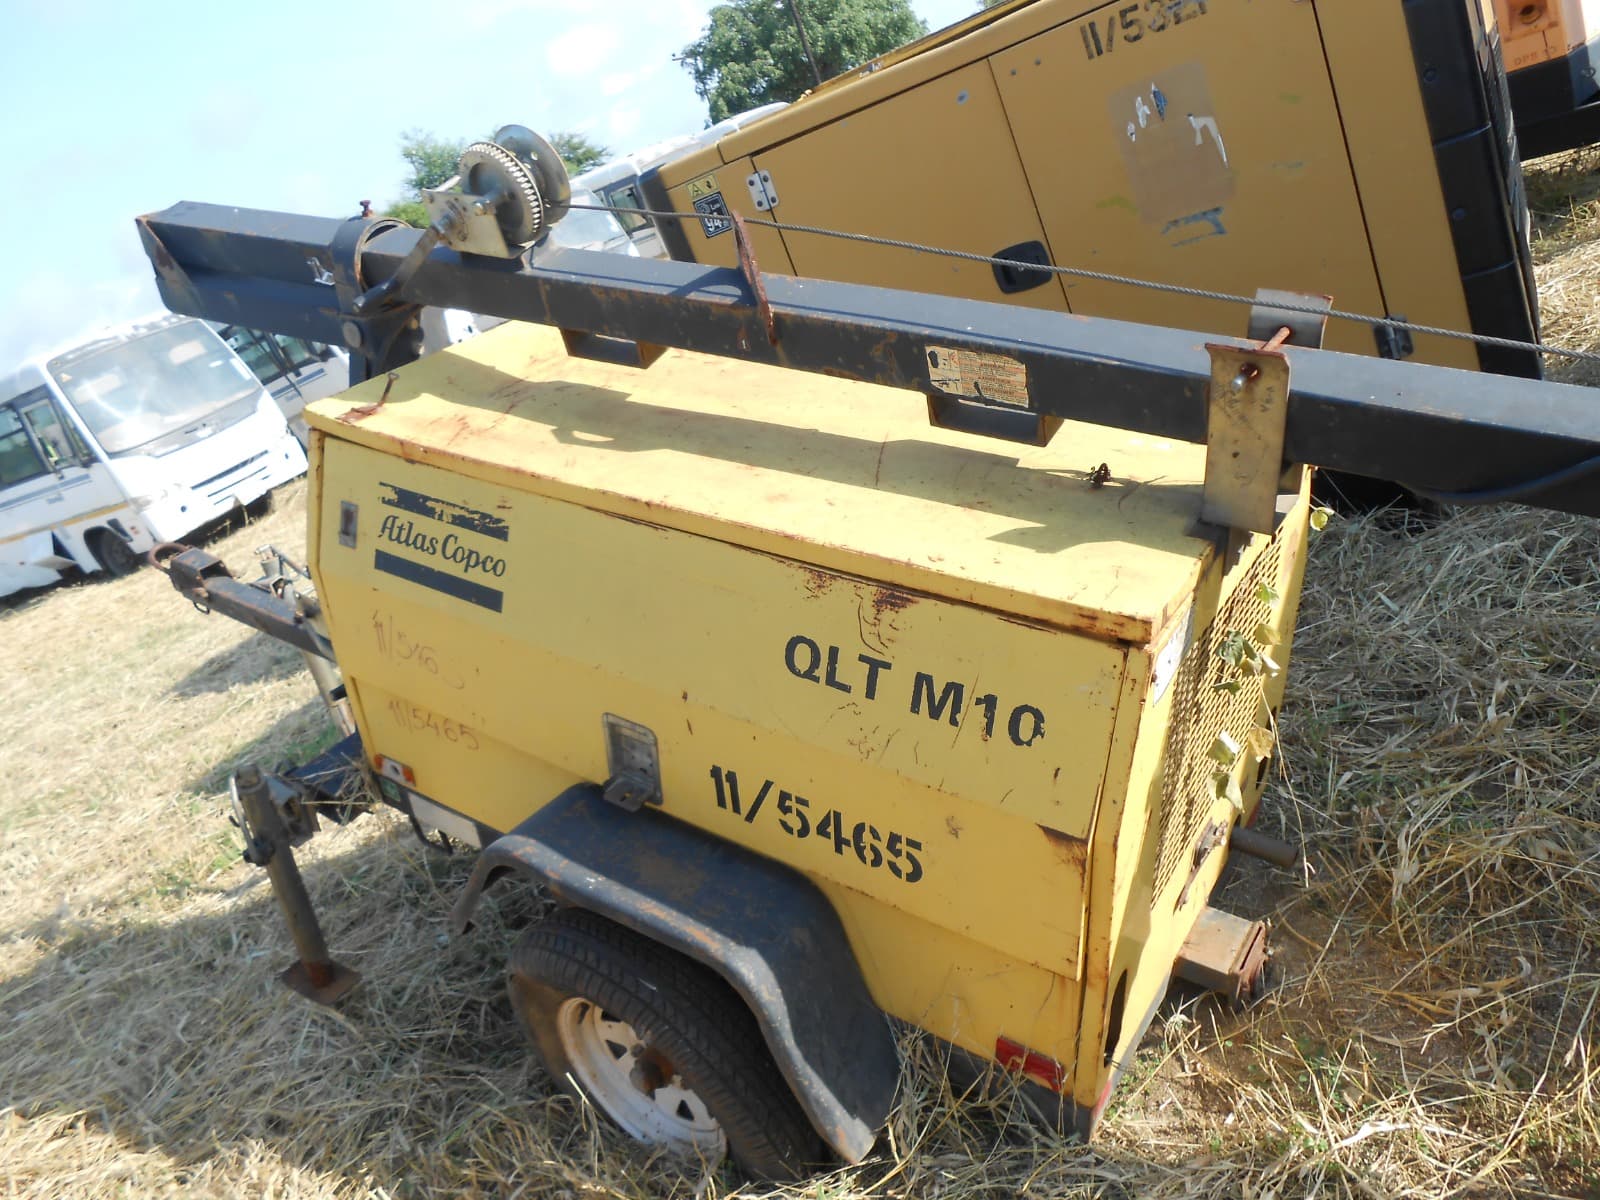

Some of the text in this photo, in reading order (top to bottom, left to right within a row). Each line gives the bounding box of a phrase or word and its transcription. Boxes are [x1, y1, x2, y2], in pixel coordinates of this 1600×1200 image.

[378, 514, 506, 577] Atlas Copco
[388, 699, 479, 750] 11/5465
[785, 635, 1045, 746] QLT M10
[710, 764, 923, 883] 11/5465
